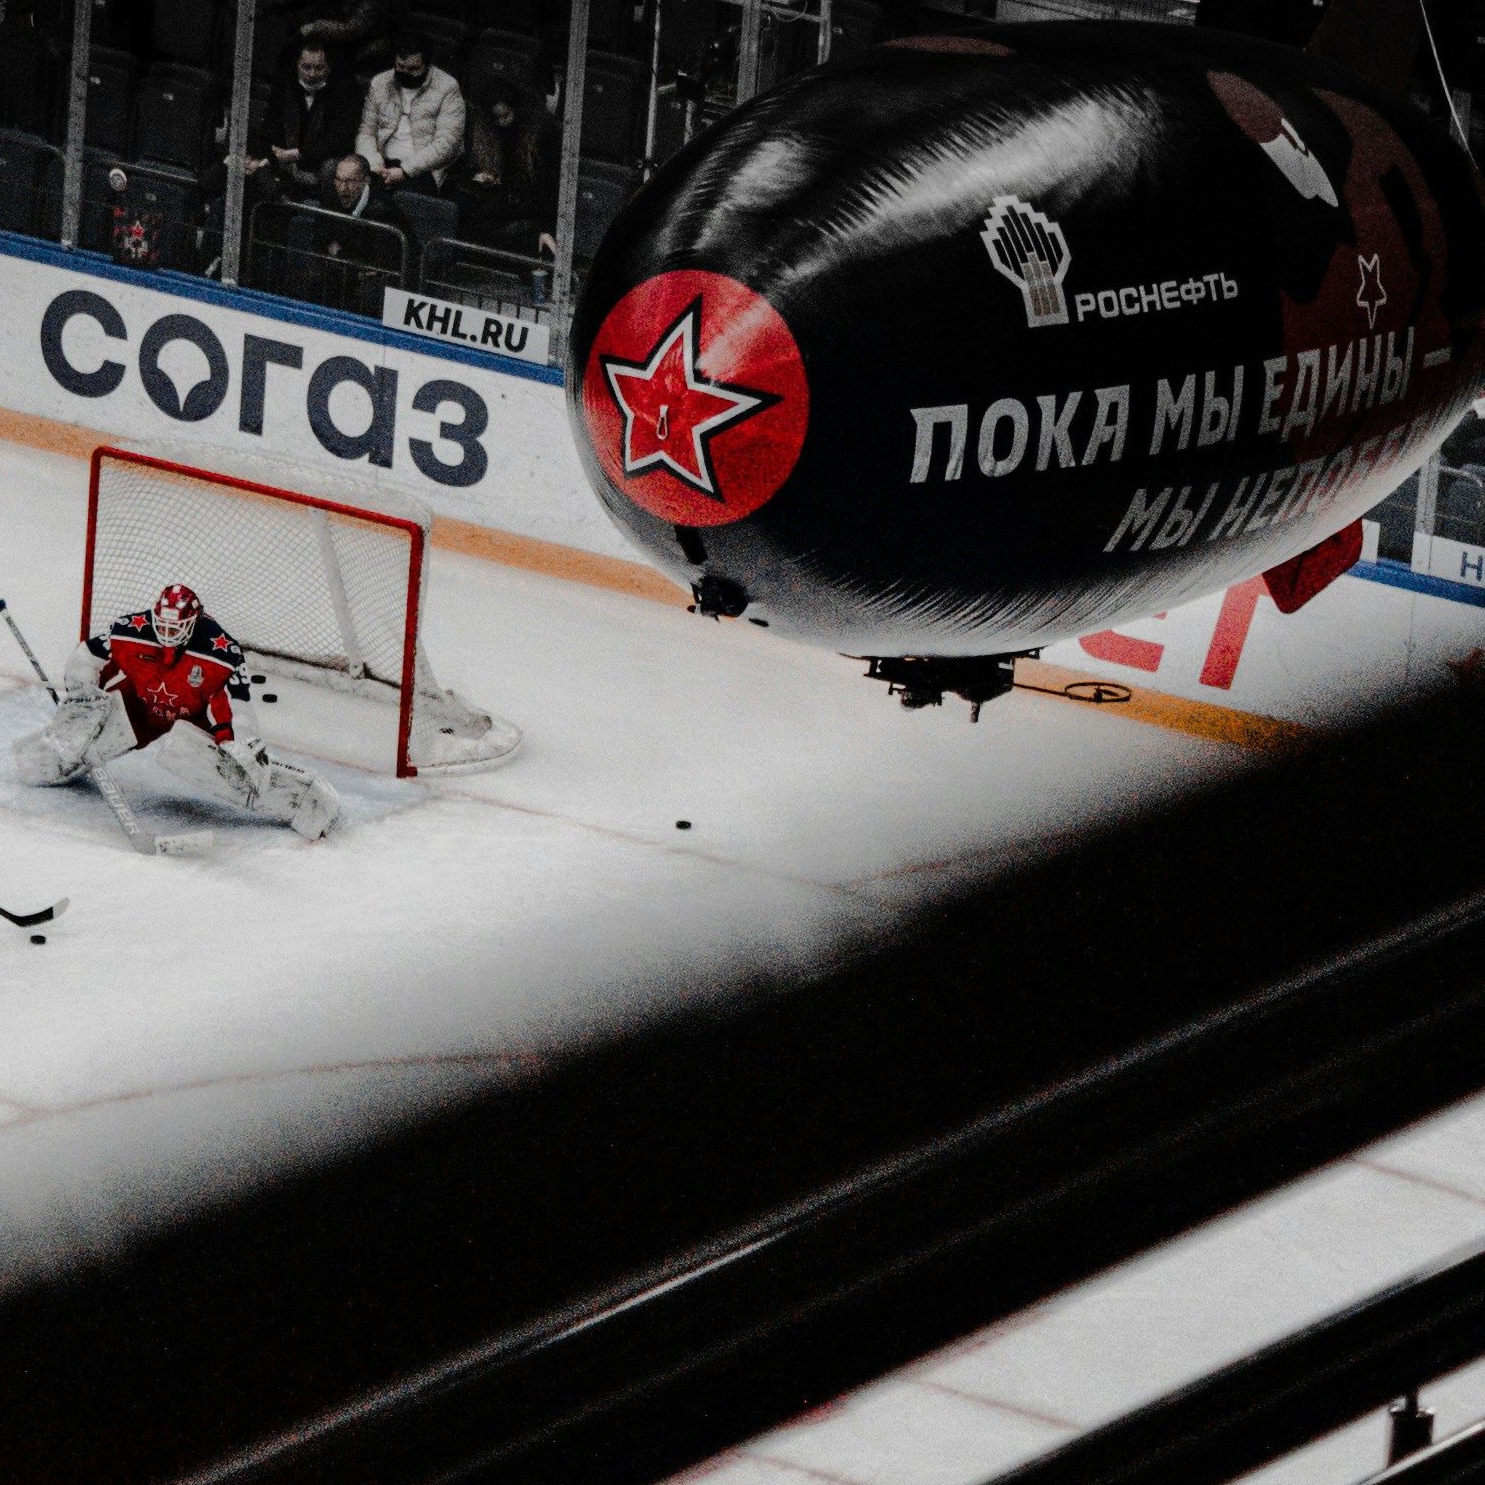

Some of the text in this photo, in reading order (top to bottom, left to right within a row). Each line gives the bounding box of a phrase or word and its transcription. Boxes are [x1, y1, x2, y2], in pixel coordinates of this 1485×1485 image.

[403, 297, 529, 355] KHL.RU
[1076, 271, 1240, 322] РОСНЕФТЬ
[909, 384, 1131, 483] ПОКА
[1149, 364, 1245, 457] МЫ
[1255, 325, 1415, 443] ЕДИНЫ
[1102, 481, 1221, 554] МЫ
